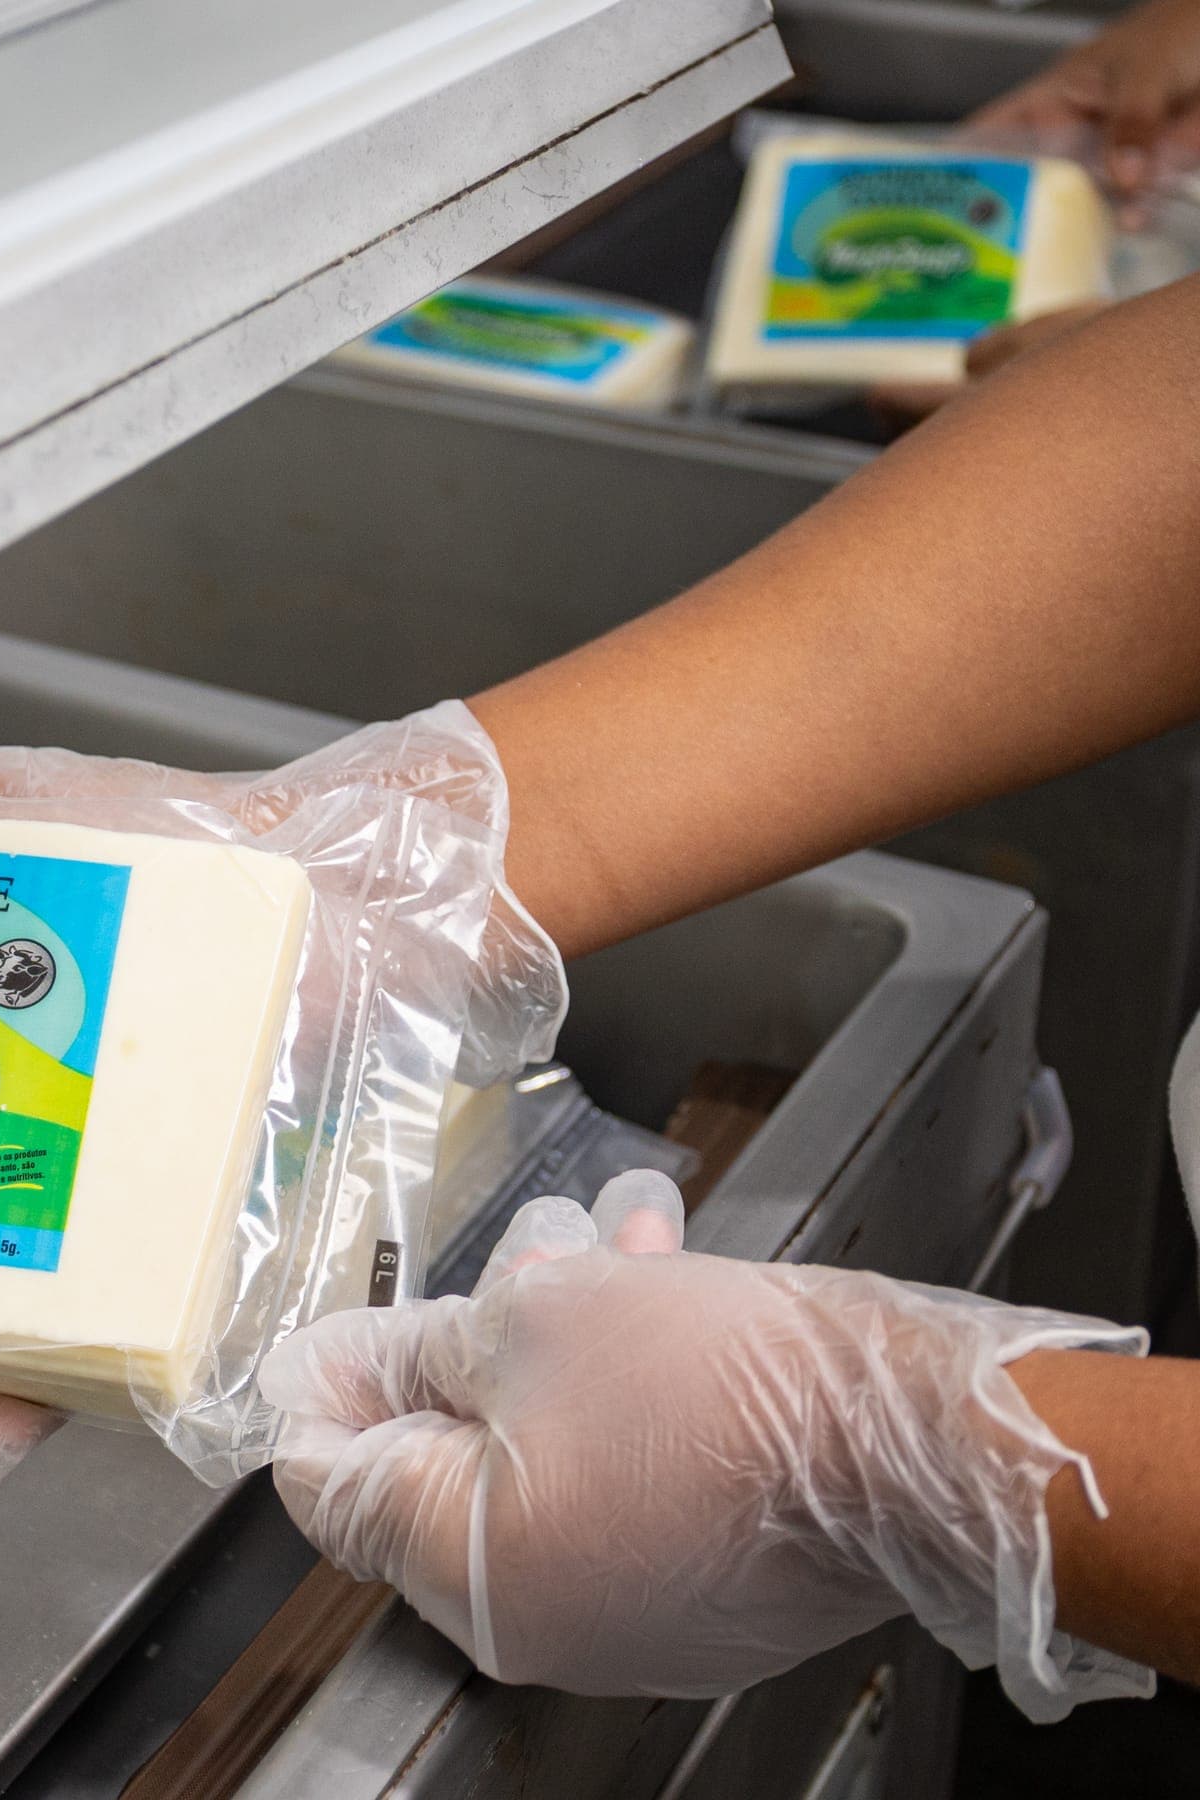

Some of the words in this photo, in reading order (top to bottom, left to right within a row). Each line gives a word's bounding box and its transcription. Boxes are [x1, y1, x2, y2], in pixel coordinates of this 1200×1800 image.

[14, 1149, 47, 1160] produtos
[21, 1160, 35, 1170] são
[7, 1172, 45, 1184] nutritivos.
[0, 1239, 21, 1257] 5g.
